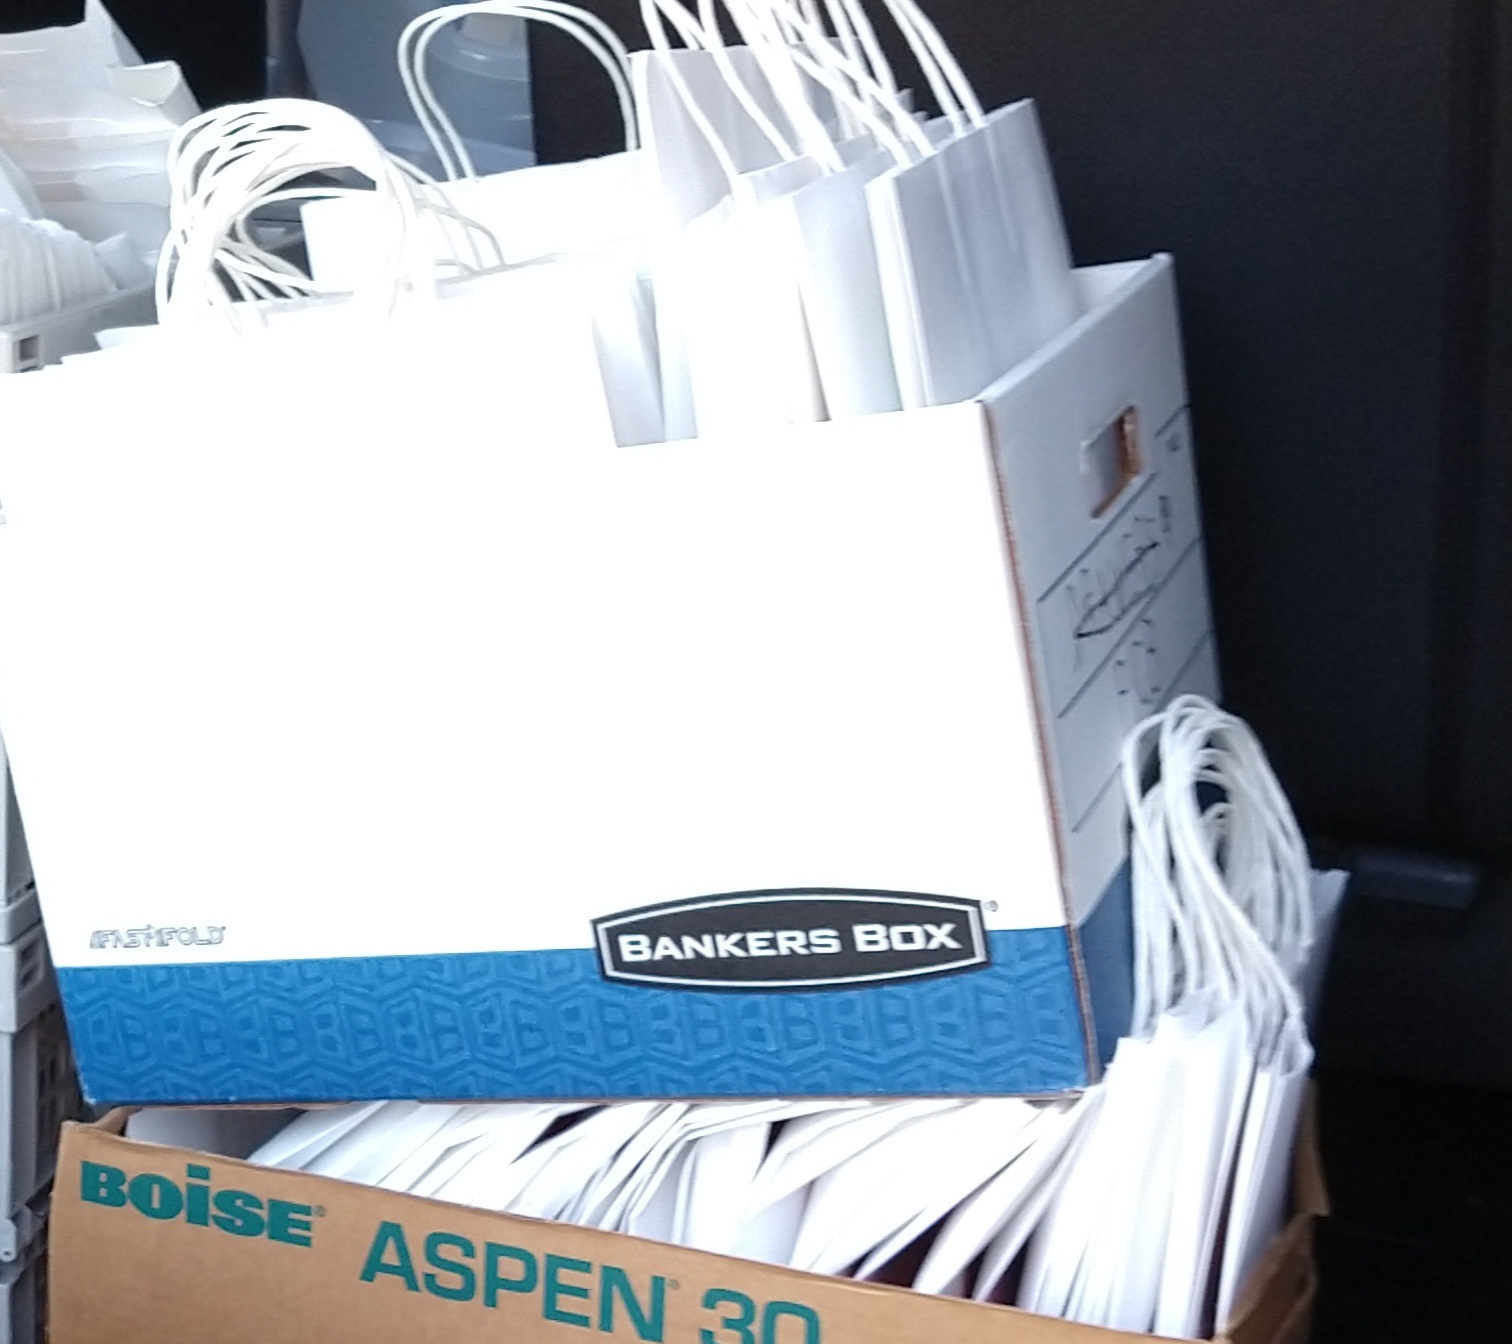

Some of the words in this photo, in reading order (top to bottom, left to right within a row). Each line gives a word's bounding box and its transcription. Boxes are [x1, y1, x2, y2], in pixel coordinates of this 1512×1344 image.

[618, 928, 841, 963] BANKERS
[852, 923, 962, 952] BOX
[360, 1221, 666, 1344] ASPEN
